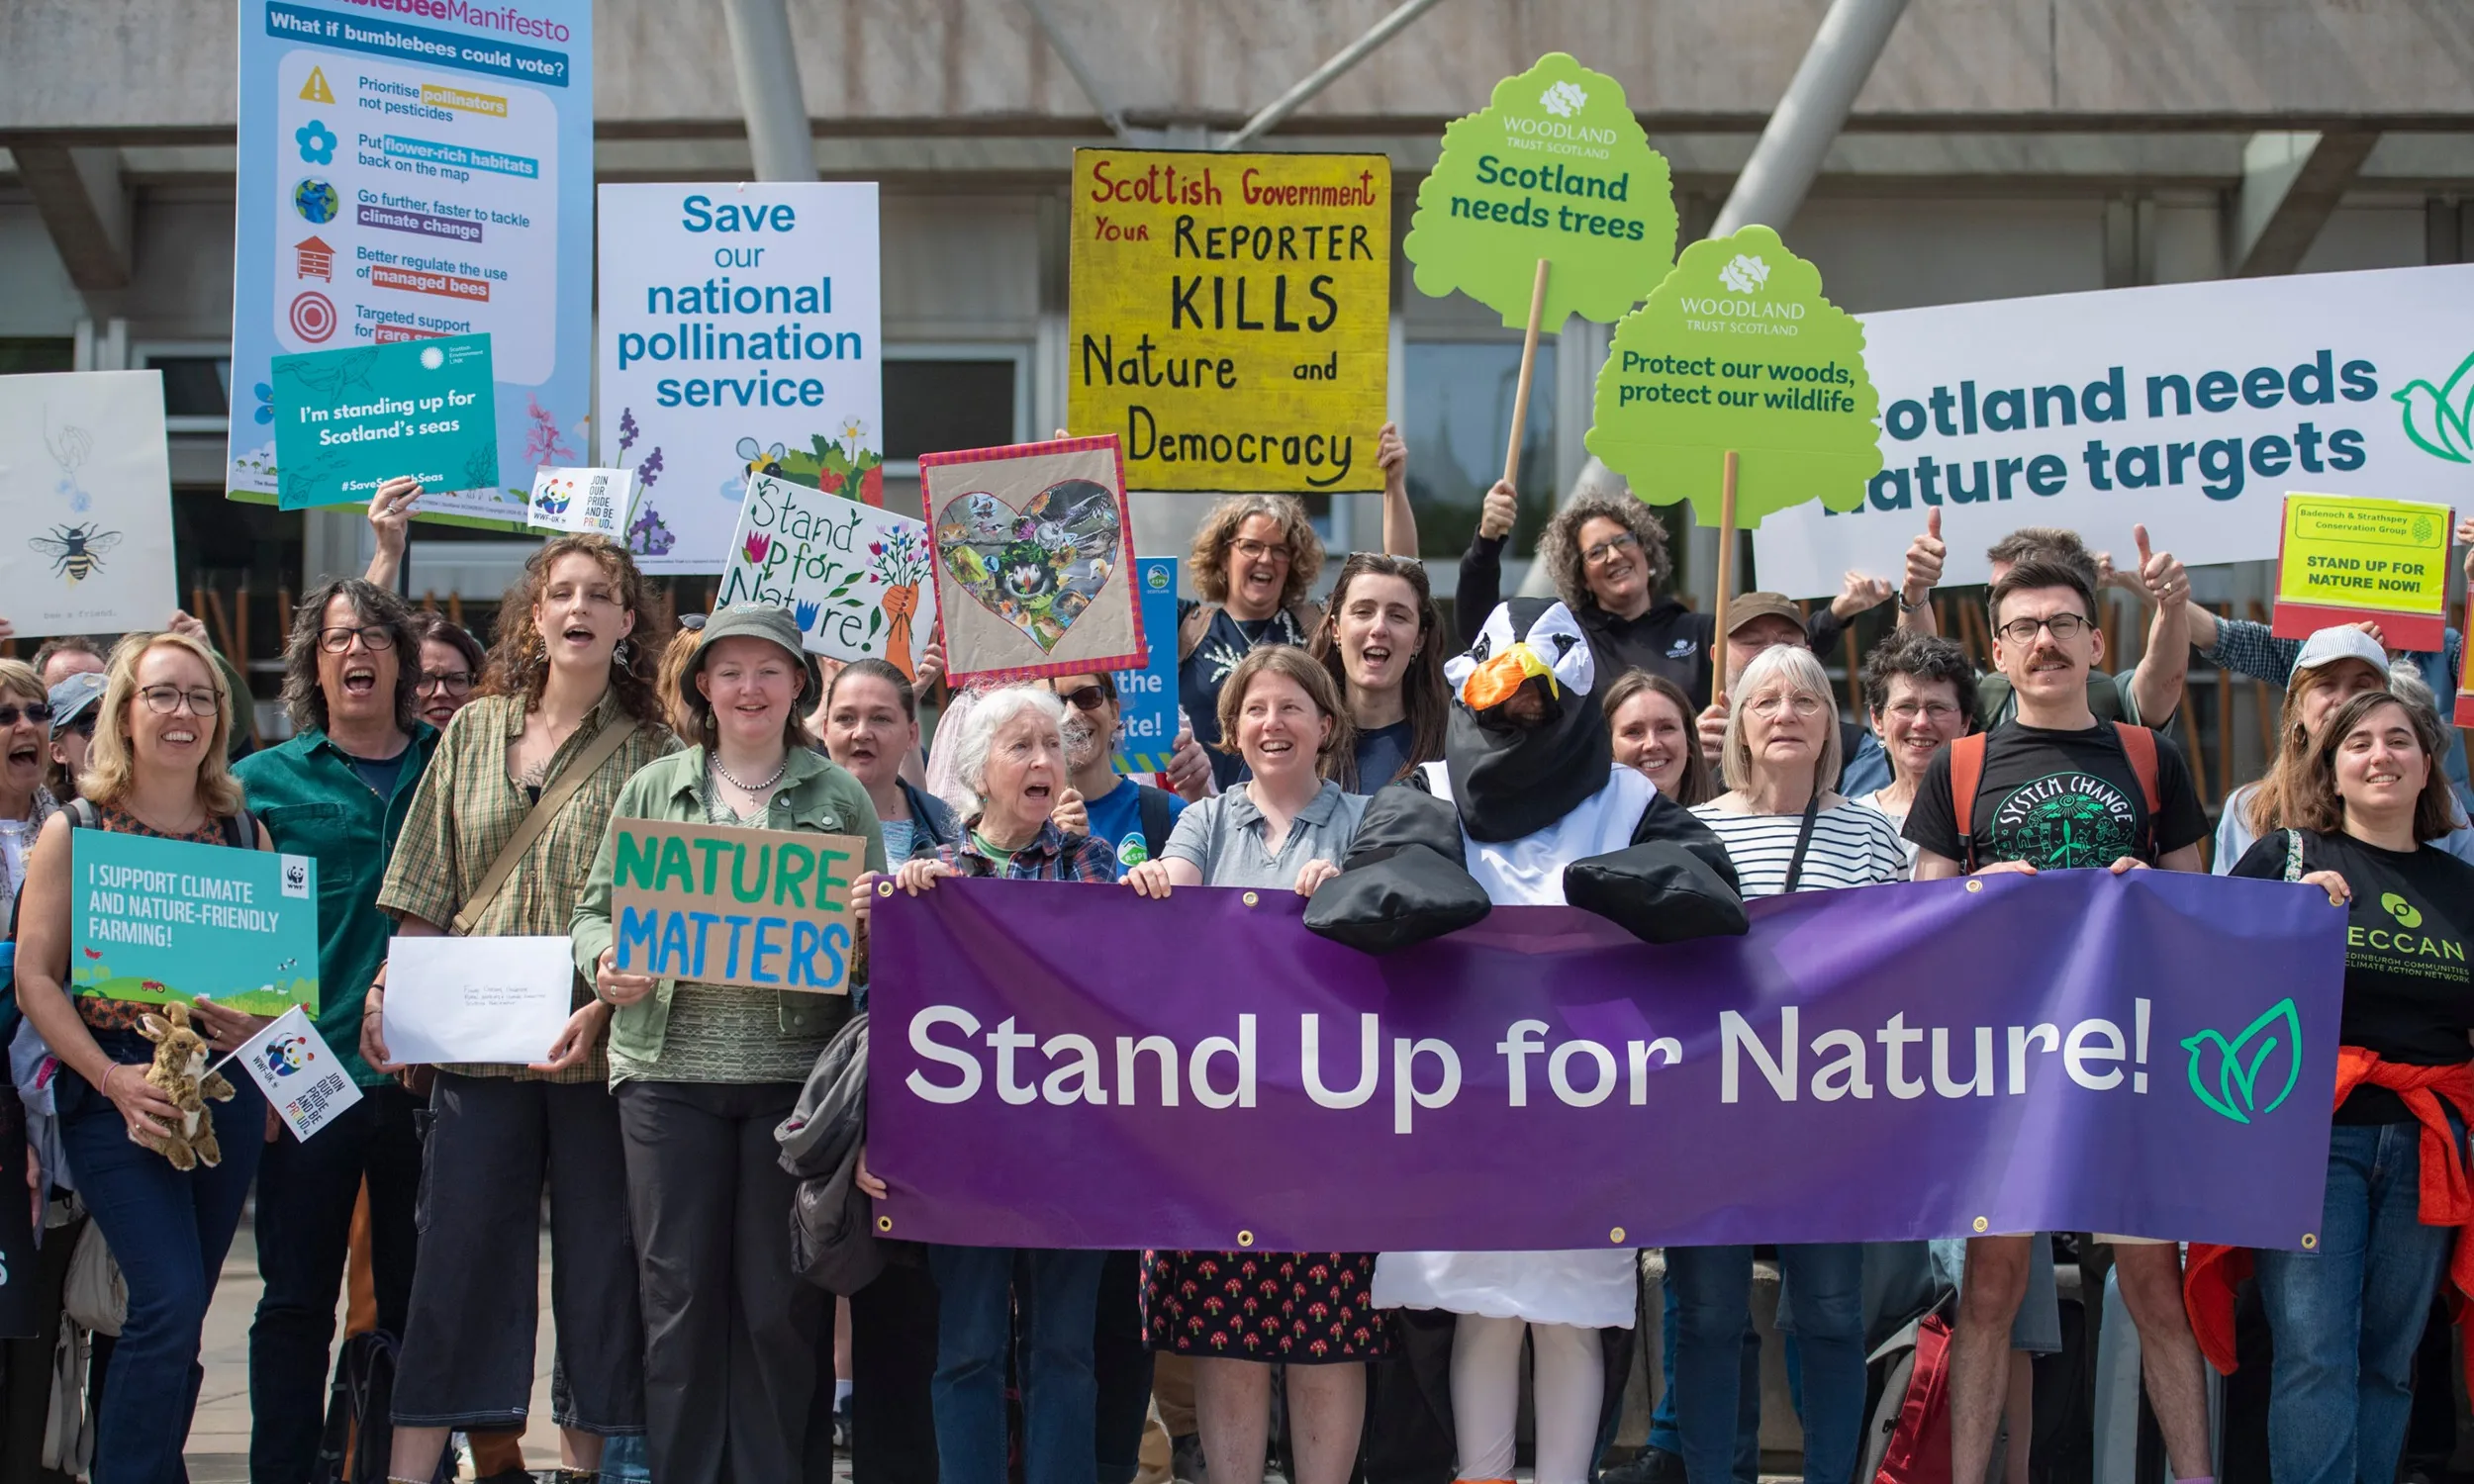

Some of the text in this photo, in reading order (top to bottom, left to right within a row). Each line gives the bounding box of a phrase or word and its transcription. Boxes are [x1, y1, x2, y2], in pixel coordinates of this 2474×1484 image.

[270, 11, 564, 77] What if bumblebees could vote?
[358, 76, 505, 113] Prioritise pollinators
[358, 96, 453, 122] not pesticides
[1503, 115, 1617, 145] WOODLAND
[358, 134, 533, 174] Put flower-rich habitats
[1507, 137, 1609, 160] TRUST SCOTLAND
[358, 152, 469, 184] back on the map
[1091, 160, 1376, 207] Scottish Government
[1475, 155, 1628, 202] Scotland
[357, 189, 530, 228] Go further, faster to tackle
[360, 209, 480, 239] climate change
[682, 195, 796, 232] Save
[1450, 196, 1645, 241] needs trees
[1175, 215, 1374, 260] REPORTER
[357, 246, 508, 281] Better regulate the use
[714, 247, 765, 268] our
[356, 266, 487, 297] of managed bees
[648, 277, 831, 315] national
[355, 305, 470, 332] Targeted support
[1172, 274, 1338, 332] KILLS
[1680, 297, 1805, 320] WOODLAND
[354, 323, 374, 338] for
[376, 328, 410, 342] rare
[1686, 320, 1798, 336] TRUST SCOTLAND
[618, 323, 862, 371] pollination
[1083, 334, 1337, 389] Nature and
[1622, 350, 1855, 388] Protect our woods,
[656, 369, 824, 407] service
[1619, 383, 1856, 414] protect our wildlife
[1877, 349, 2378, 442] otland needs
[300, 390, 476, 423] I'm standing up for
[320, 418, 460, 446] Scotland's seas
[1128, 404, 1352, 487] Democracy
[591, 475, 609, 486] JOIN
[1824, 421, 2366, 516] ature targets
[587, 496, 610, 508] PRIDE
[589, 486, 605, 496] OUR
[534, 513, 560, 522] WWF-UK
[585, 507, 615, 519] AND BE
[751, 479, 862, 553] Stand
[2300, 509, 2345, 519] Badenoch
[2357, 512, 2408, 524] Strathspey
[2315, 520, 2407, 535] Conservation Group
[793, 543, 842, 584] for
[2307, 556, 2425, 575] STAND UP FOR
[2309, 574, 2421, 593] NATURE NOW!
[1117, 670, 1162, 693] the
[1999, 776, 2133, 824] SYSTEM CHANGE
[89, 863, 253, 904] I SUPPORT CLIMATE
[613, 831, 850, 912] NATURE
[89, 890, 280, 933] AND NATURE-FRIENDLY
[89, 917, 172, 948] FARMING!
[617, 906, 851, 988] MATTERS
[2347, 926, 2465, 962] ECCAN
[2345, 952, 2470, 975] EDINBURGH COMMUNITIES
[2387, 966, 2423, 976] ACTION
[2425, 971, 2470, 983] NETWORK
[252, 1055, 275, 1083] WWF-UK
[904, 997, 2151, 1134] Stand Up for Nature!
[317, 1078, 334, 1098] OUR
[326, 1072, 346, 1093] JOIN
[295, 1094, 324, 1125] AND BE
[307, 1086, 330, 1112] PRIDE
